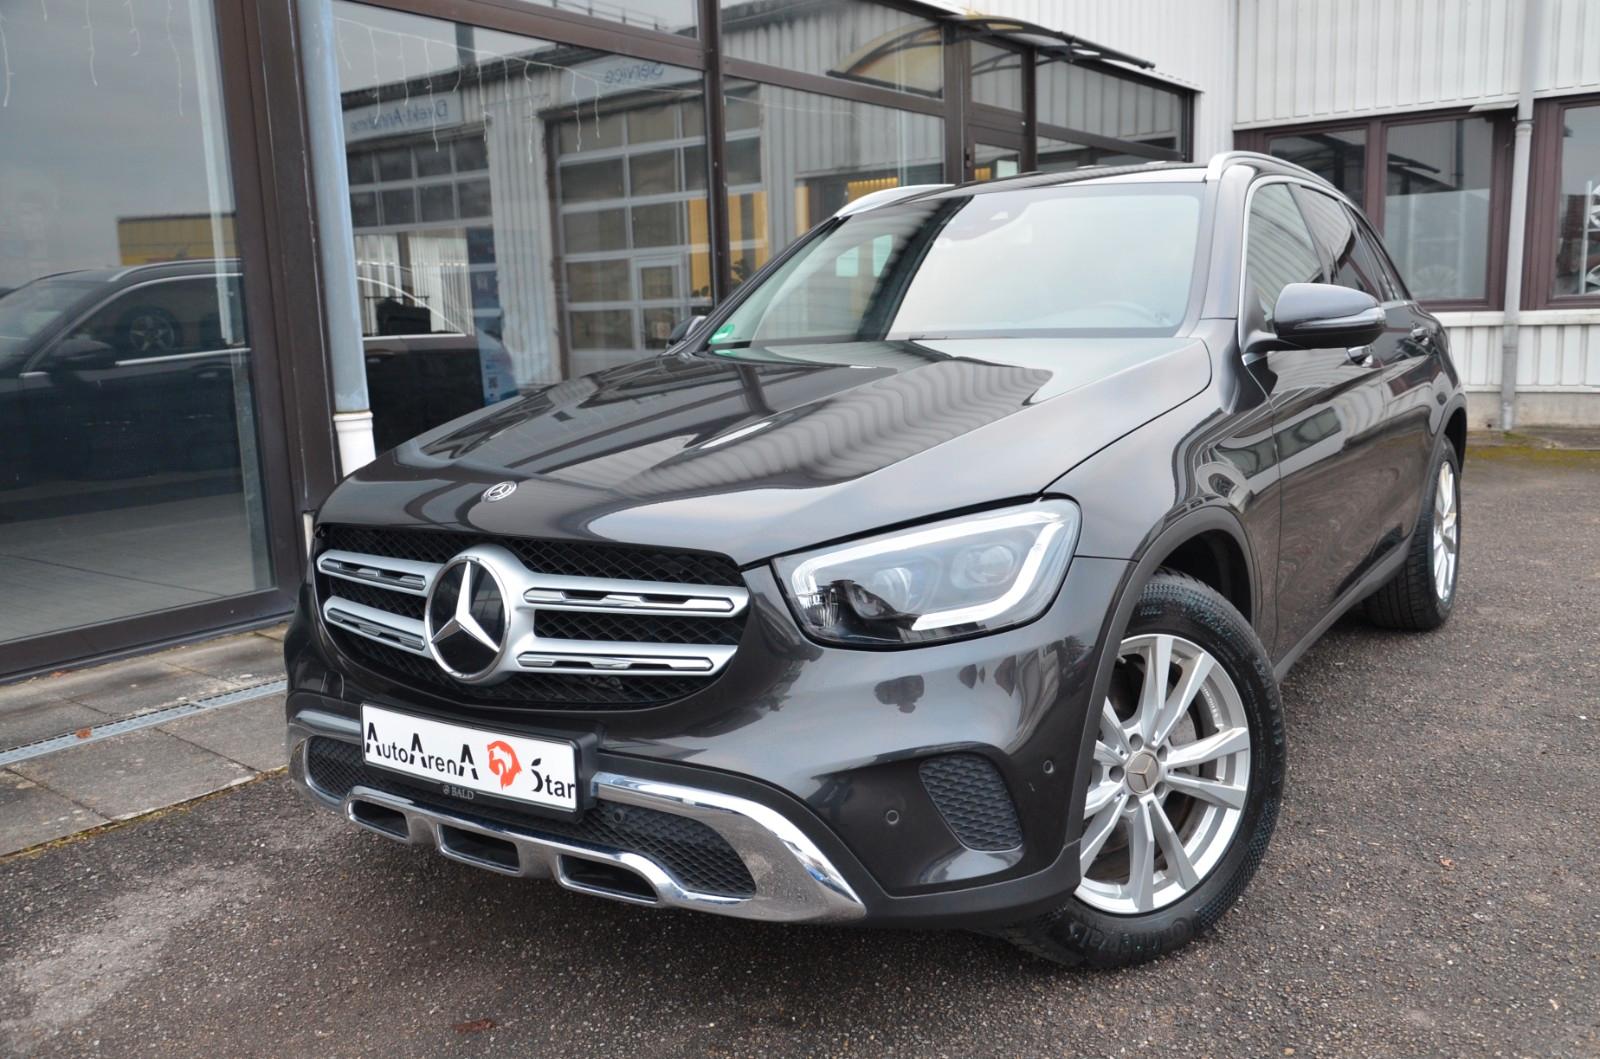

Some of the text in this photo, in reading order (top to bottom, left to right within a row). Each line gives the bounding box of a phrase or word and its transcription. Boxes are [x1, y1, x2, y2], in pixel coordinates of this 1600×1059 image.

[366, 722, 576, 799] AutoArenA Star
[451, 785, 475, 800] BALD
